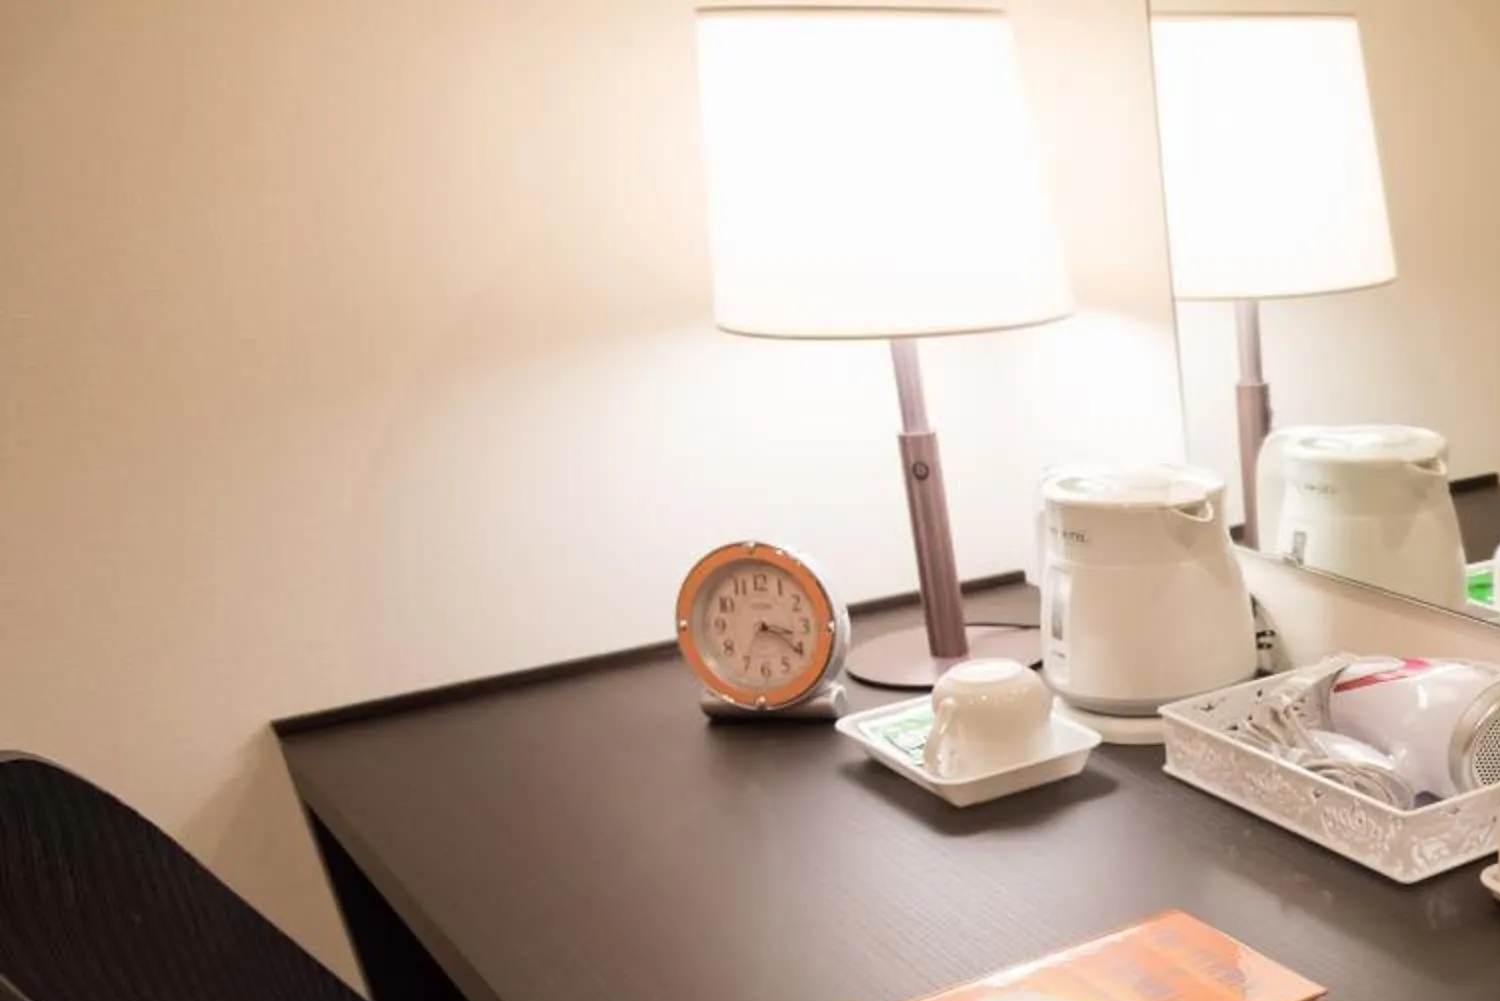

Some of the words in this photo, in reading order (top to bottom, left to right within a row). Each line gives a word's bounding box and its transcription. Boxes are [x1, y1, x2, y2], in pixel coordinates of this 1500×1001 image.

[733, 578, 747, 596] 11
[753, 573, 768, 592] 12
[719, 597, 735, 613] 10
[791, 594, 800, 612] 2
[714, 618, 727, 635] 9
[801, 618, 811, 635] 3
[723, 640, 735, 656] 8
[742, 656, 752, 672] 7
[760, 662, 772, 678] 6
[781, 657, 791, 674] 5
